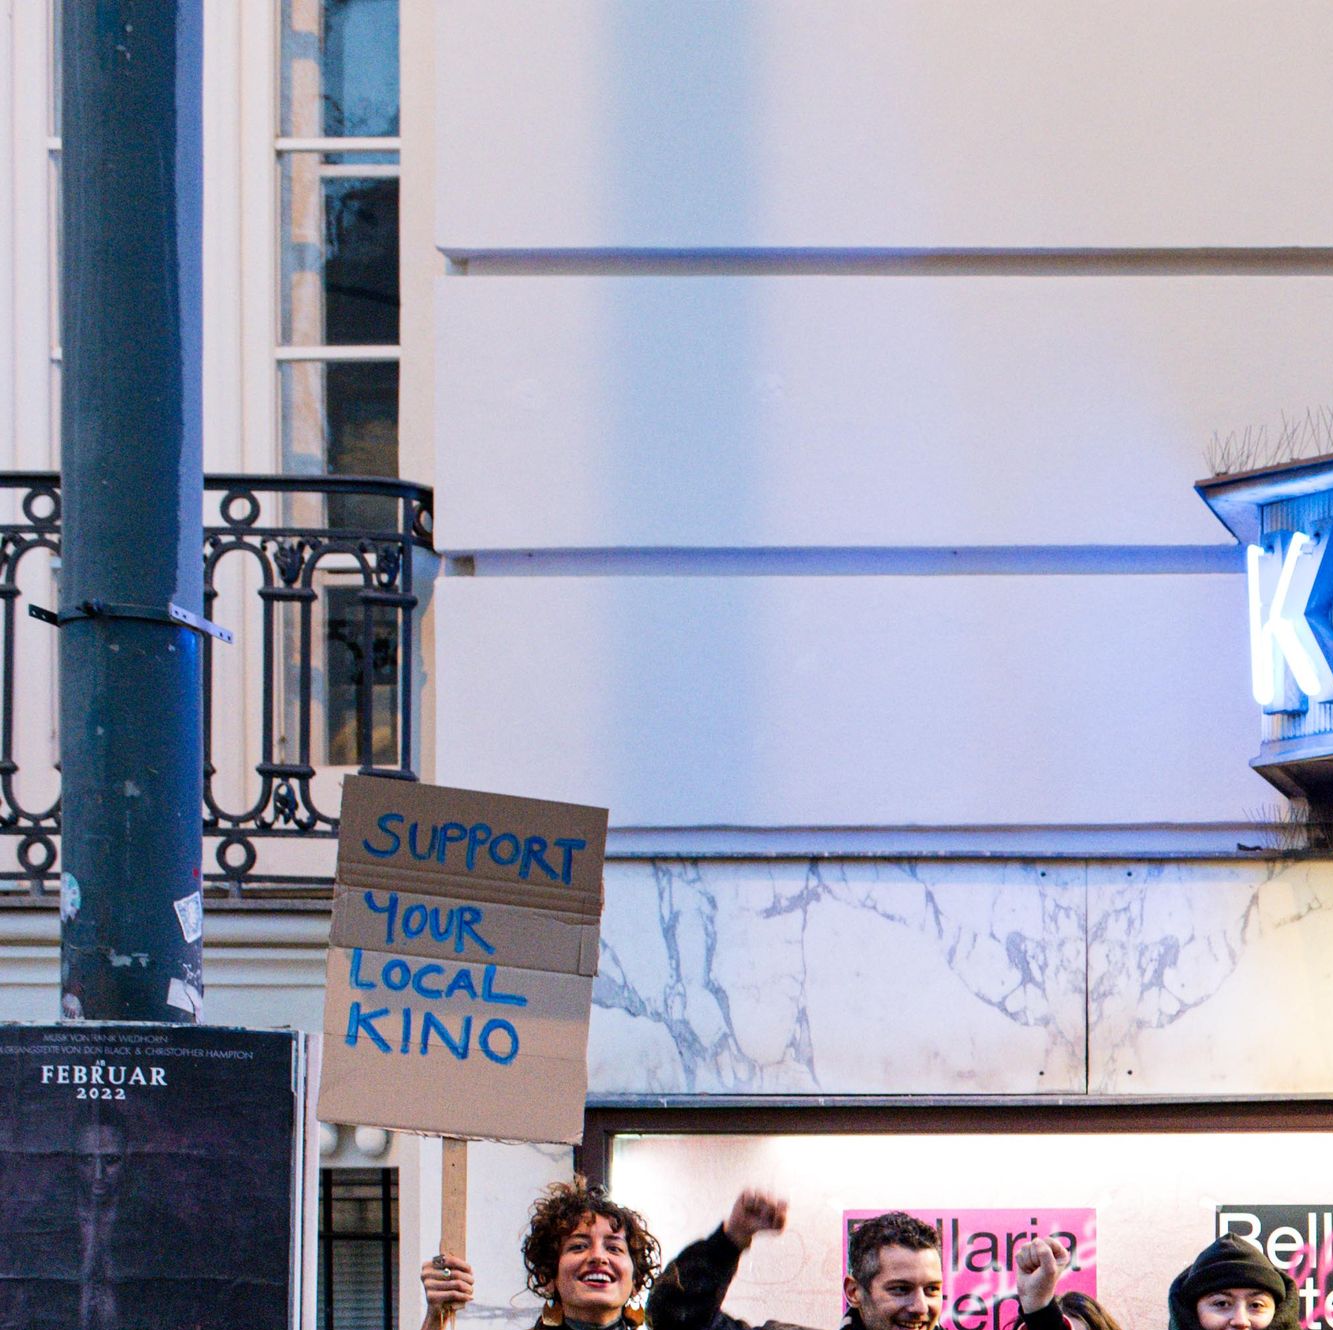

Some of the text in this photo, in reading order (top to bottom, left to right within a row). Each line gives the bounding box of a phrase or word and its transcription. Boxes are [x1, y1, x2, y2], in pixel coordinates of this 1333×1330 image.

[362, 812, 588, 885] SUPPORT
[364, 891, 496, 955] YOUR
[350, 947, 528, 1006] LOCAL
[205, 1050, 254, 1060] HAMPTON
[345, 1001, 519, 1065] KINO
[41, 1065, 168, 1086] FEBRUAR
[76, 1088, 126, 1100] 2022
